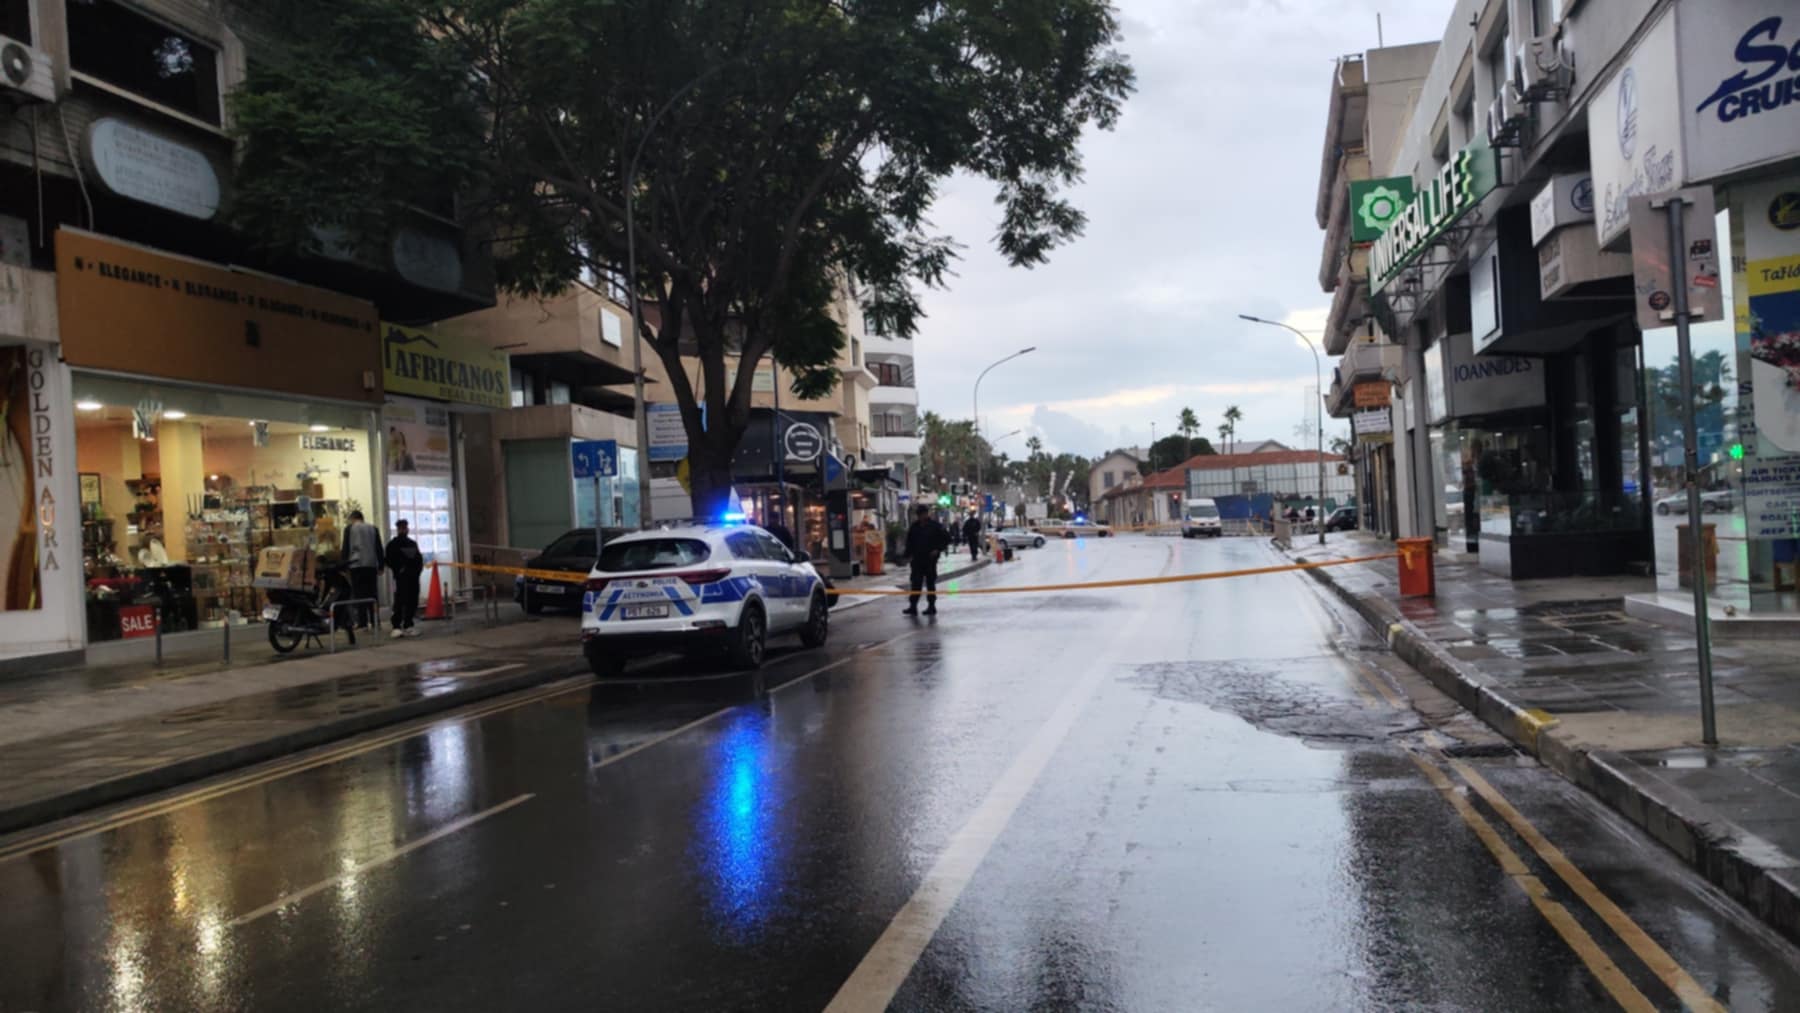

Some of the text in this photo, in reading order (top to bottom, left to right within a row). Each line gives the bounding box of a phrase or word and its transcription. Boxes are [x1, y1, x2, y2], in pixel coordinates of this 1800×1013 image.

[1369, 190, 1430, 281] UNIVERSAL
[1430, 151, 1465, 227] LIFE
[395, 349, 505, 394] AFRICANOS
[1454, 357, 1532, 382] IOANNIDES
[29, 350, 59, 571] GOLDEN AURA
[303, 436, 356, 452] ELEGANCE
[122, 615, 153, 632] SALE
